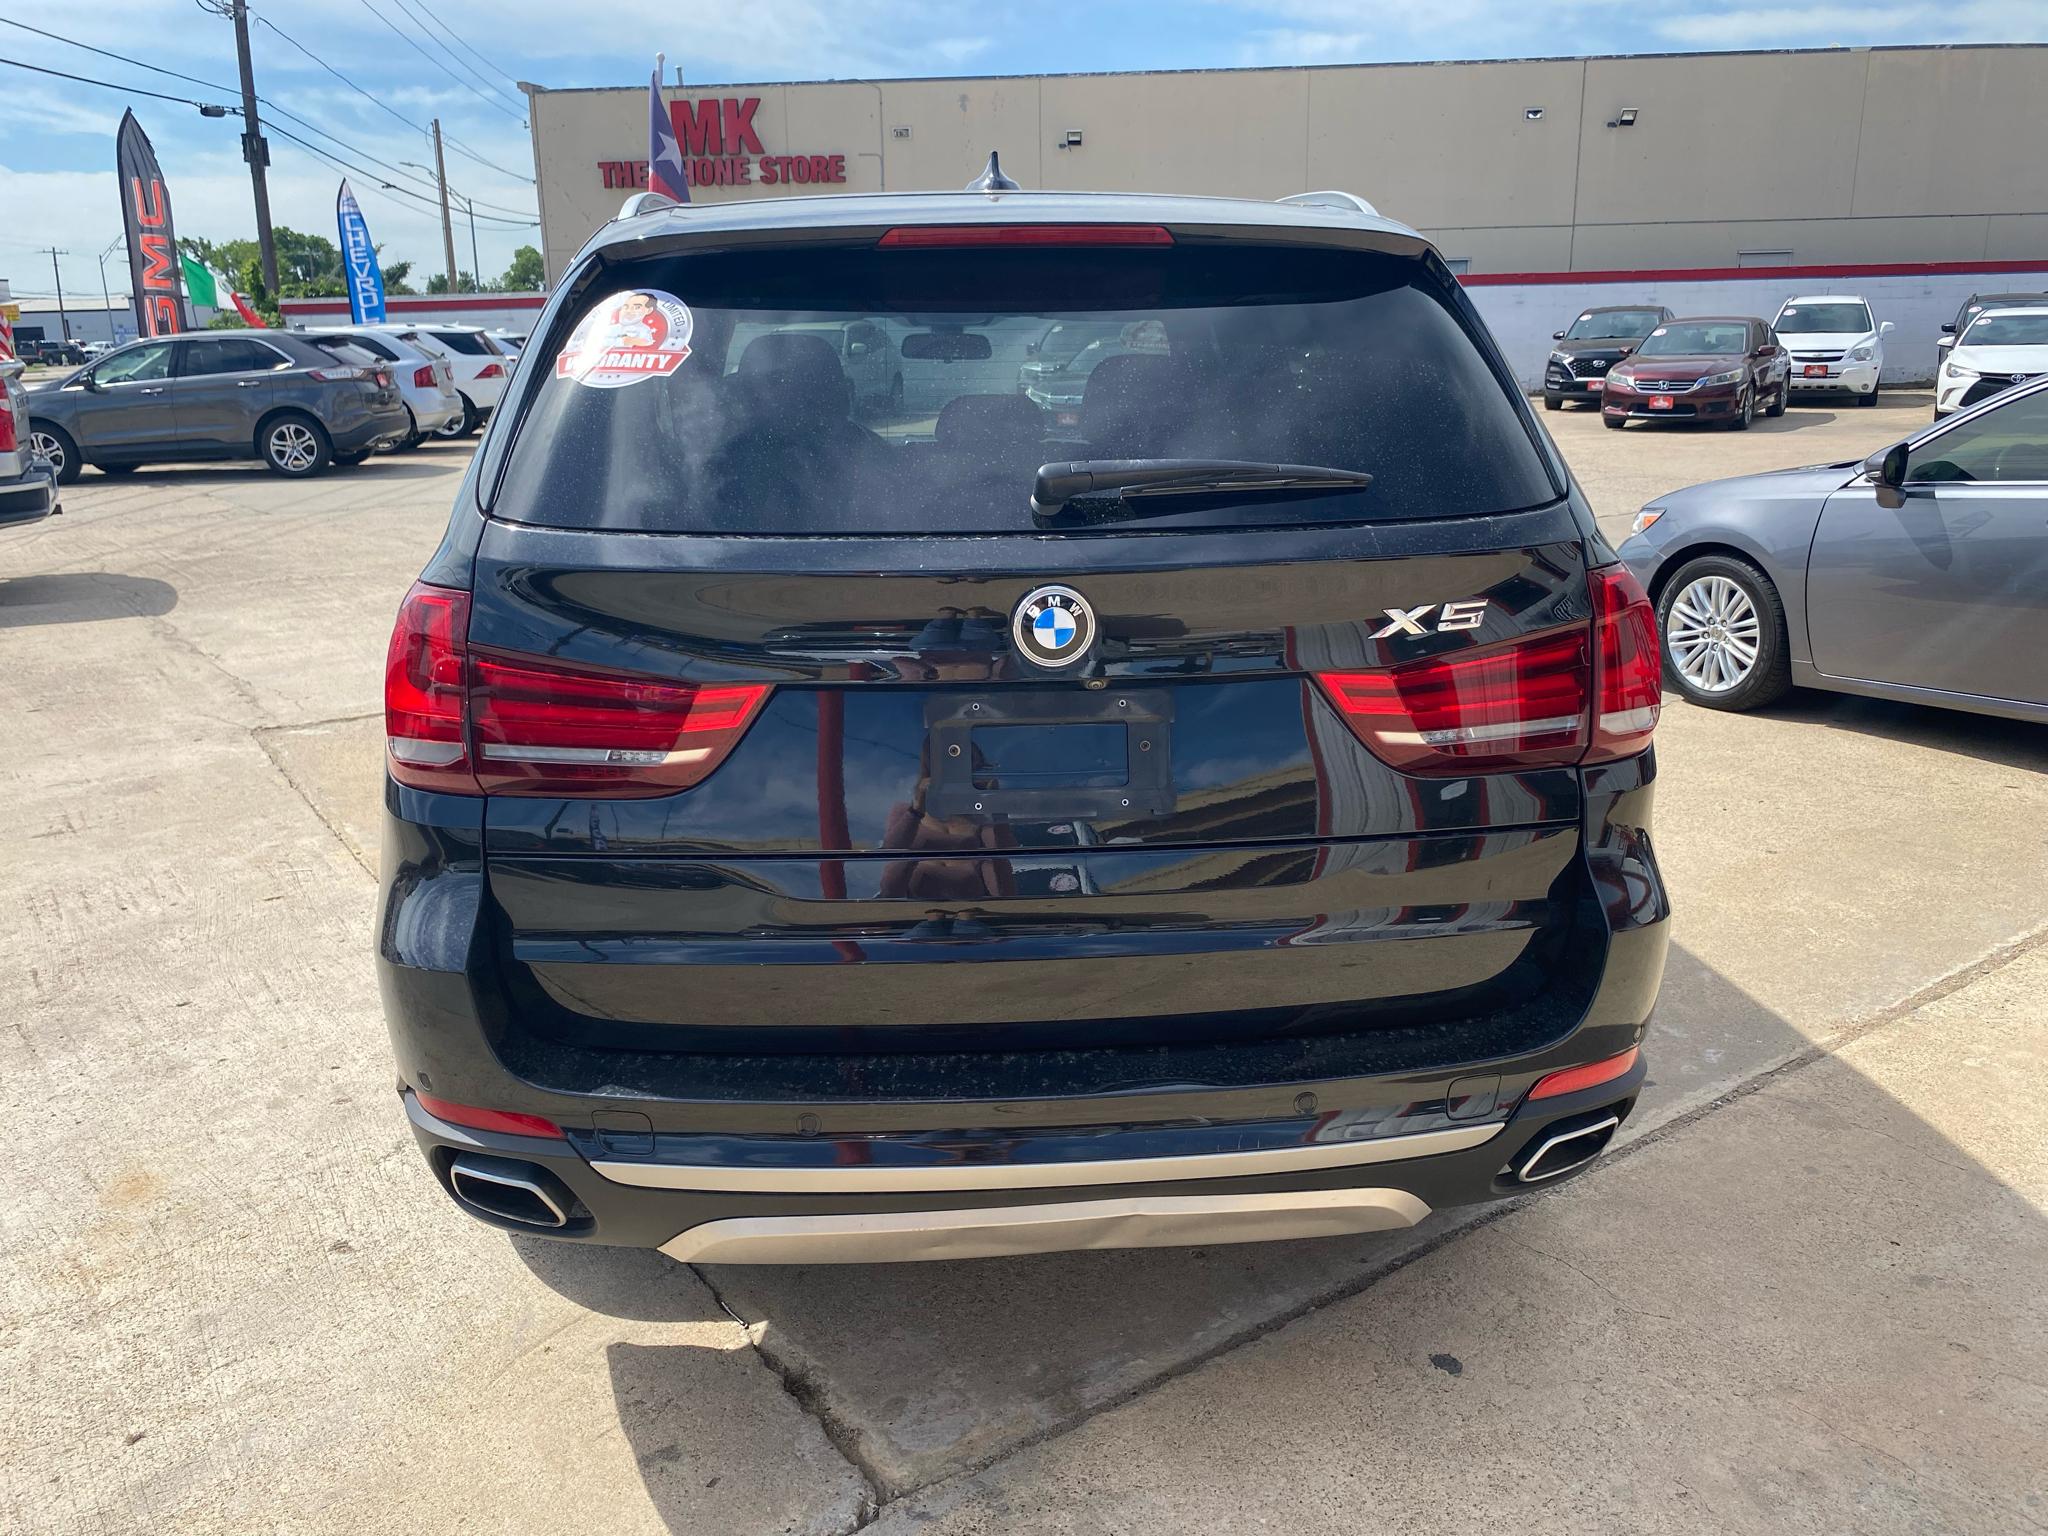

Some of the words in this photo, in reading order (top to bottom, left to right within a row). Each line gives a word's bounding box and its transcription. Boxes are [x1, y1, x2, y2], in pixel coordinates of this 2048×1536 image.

[670, 98, 765, 156] MK
[598, 160, 649, 188] THE
[682, 157, 751, 186] HONE
[759, 155, 846, 184] STORE
[132, 177, 180, 338] GMC
[345, 214, 380, 326] CHEVROL
[1027, 596, 1083, 619] BMW
[1368, 599, 1488, 639] X5
